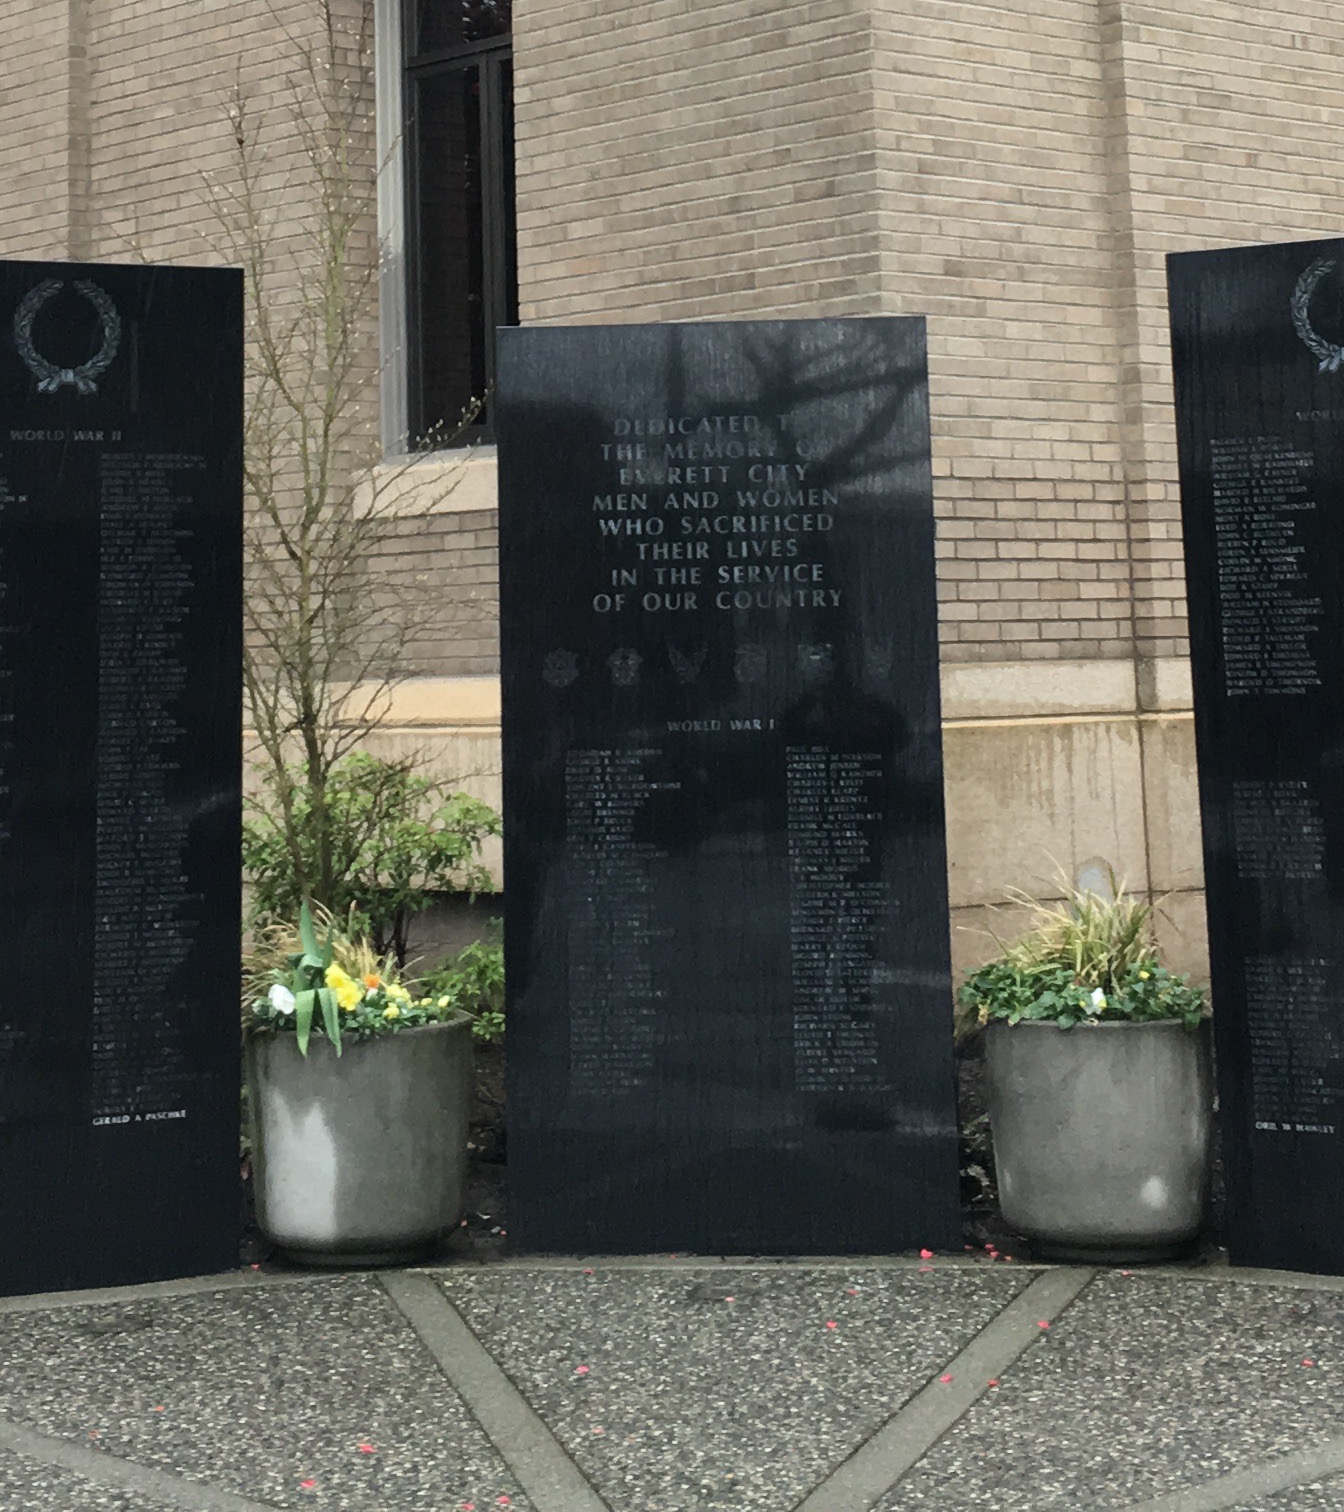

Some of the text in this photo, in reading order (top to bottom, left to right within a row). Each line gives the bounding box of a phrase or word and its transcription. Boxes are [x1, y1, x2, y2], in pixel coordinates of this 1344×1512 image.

[9, 430, 122, 441] WORLD WAR II
[614, 415, 762, 436] DEDICATED
[600, 442, 647, 461] THE
[664, 439, 778, 459] MEMORY
[748, 464, 810, 484] CITY
[592, 489, 839, 511] MEN AND WOMEN
[599, 513, 834, 536] WHO SACRIFICED
[636, 539, 798, 560] THEIR LIVES
[611, 564, 824, 586] IN THE SERVICE
[592, 589, 842, 613] OF OUR COUNTRY
[667, 720, 721, 731] WORLD
[730, 719, 761, 731] WAR
[92, 1115, 131, 1126] GERALD
[134, 1114, 142, 1122] A
